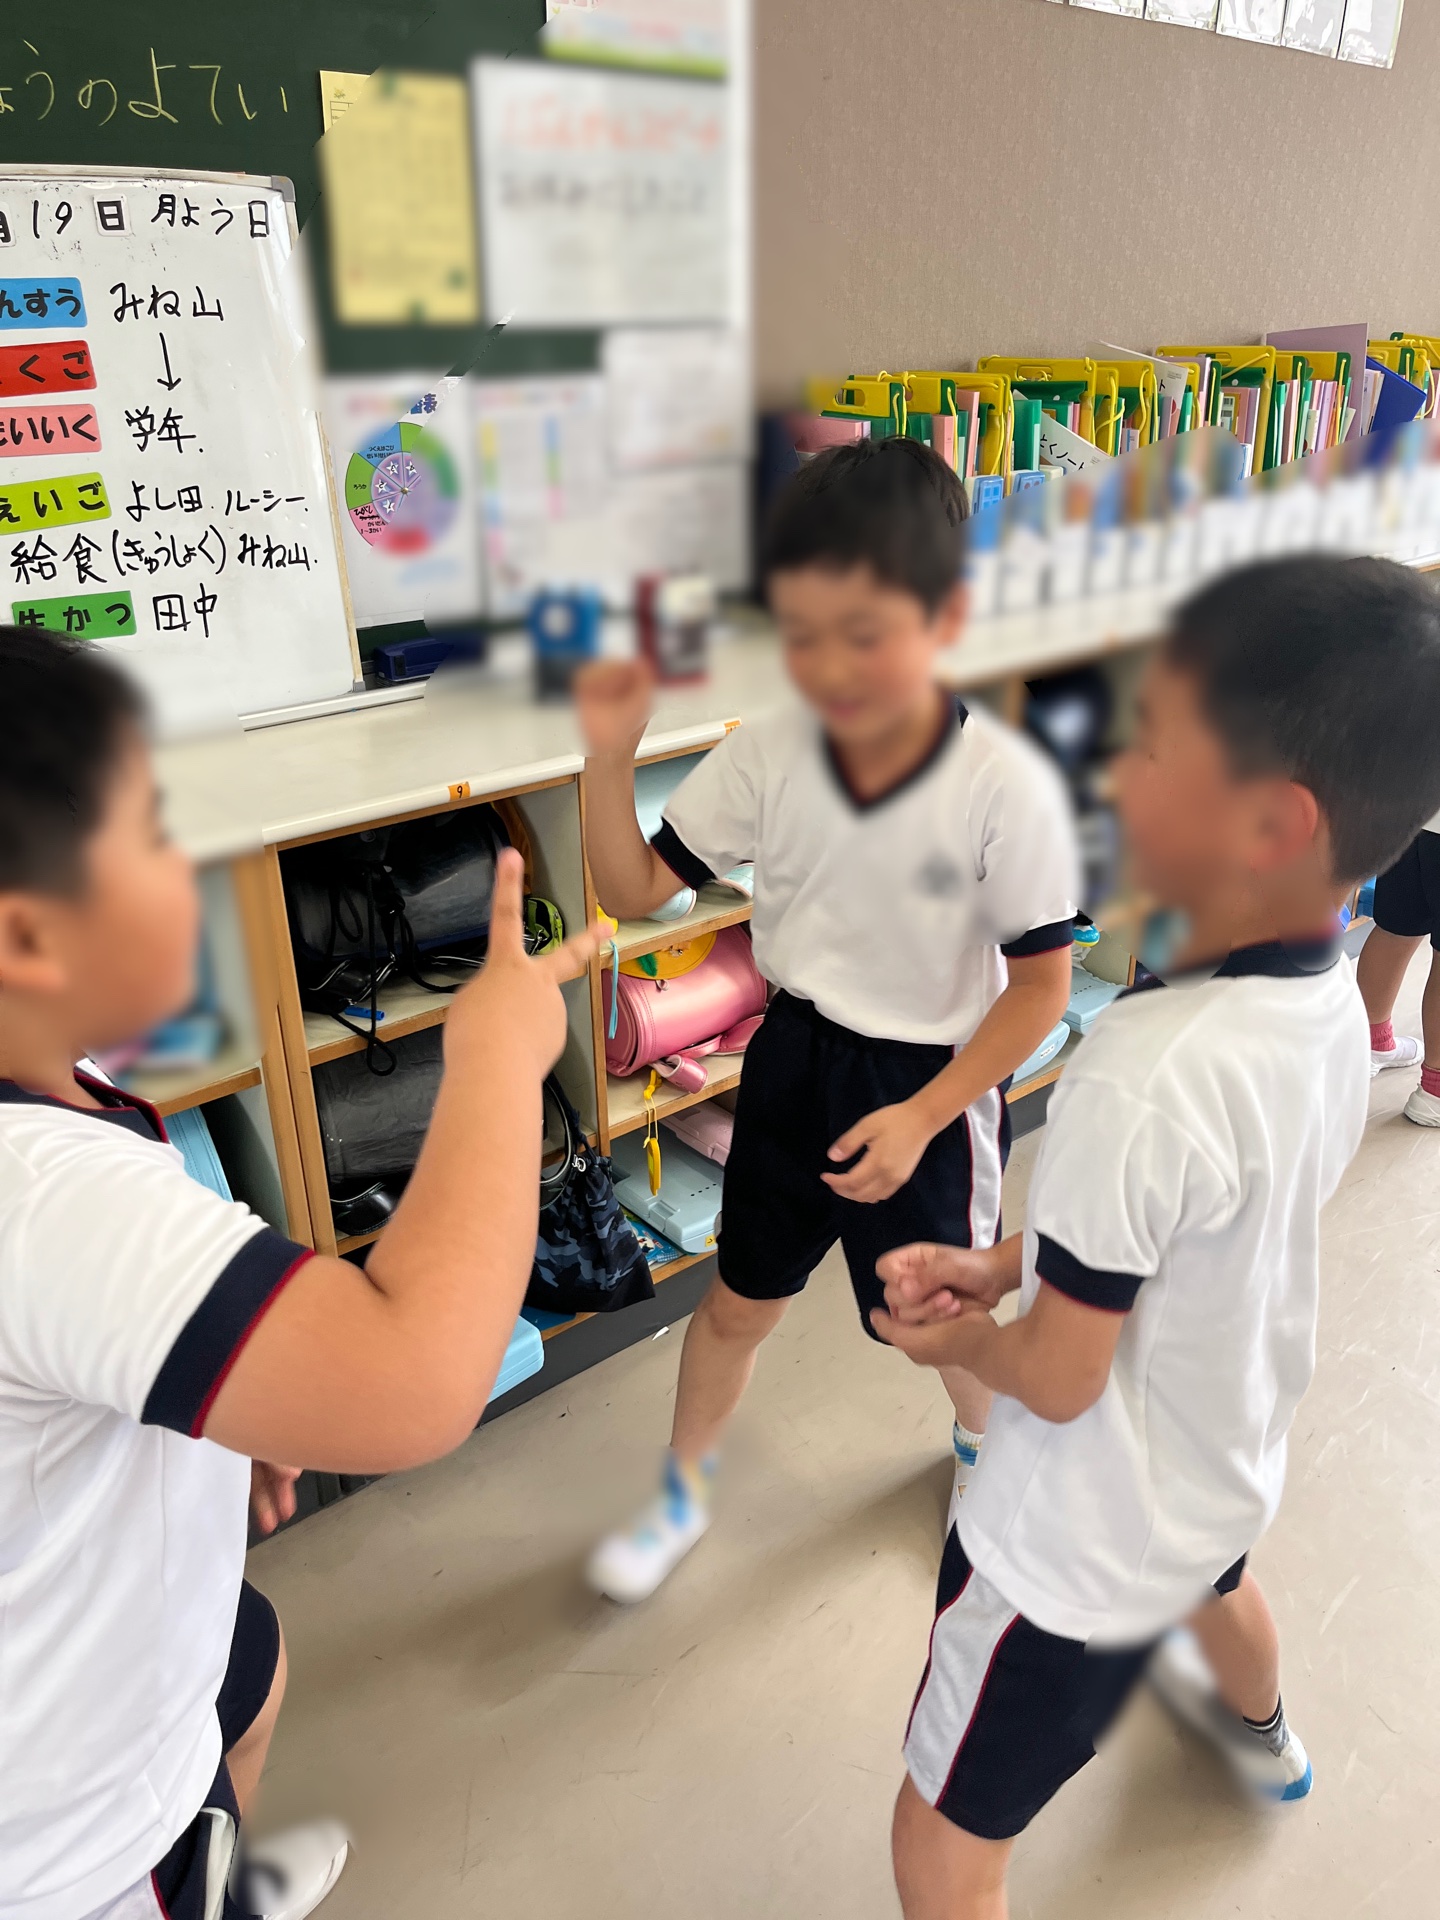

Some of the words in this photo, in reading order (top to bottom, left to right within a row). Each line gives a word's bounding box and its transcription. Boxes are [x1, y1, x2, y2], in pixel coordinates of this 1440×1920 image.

[109, 282, 224, 323] みね山
[0, 481, 106, 523] えいご
[152, 582, 218, 638] 田中
[456, 785, 463, 799] 9
